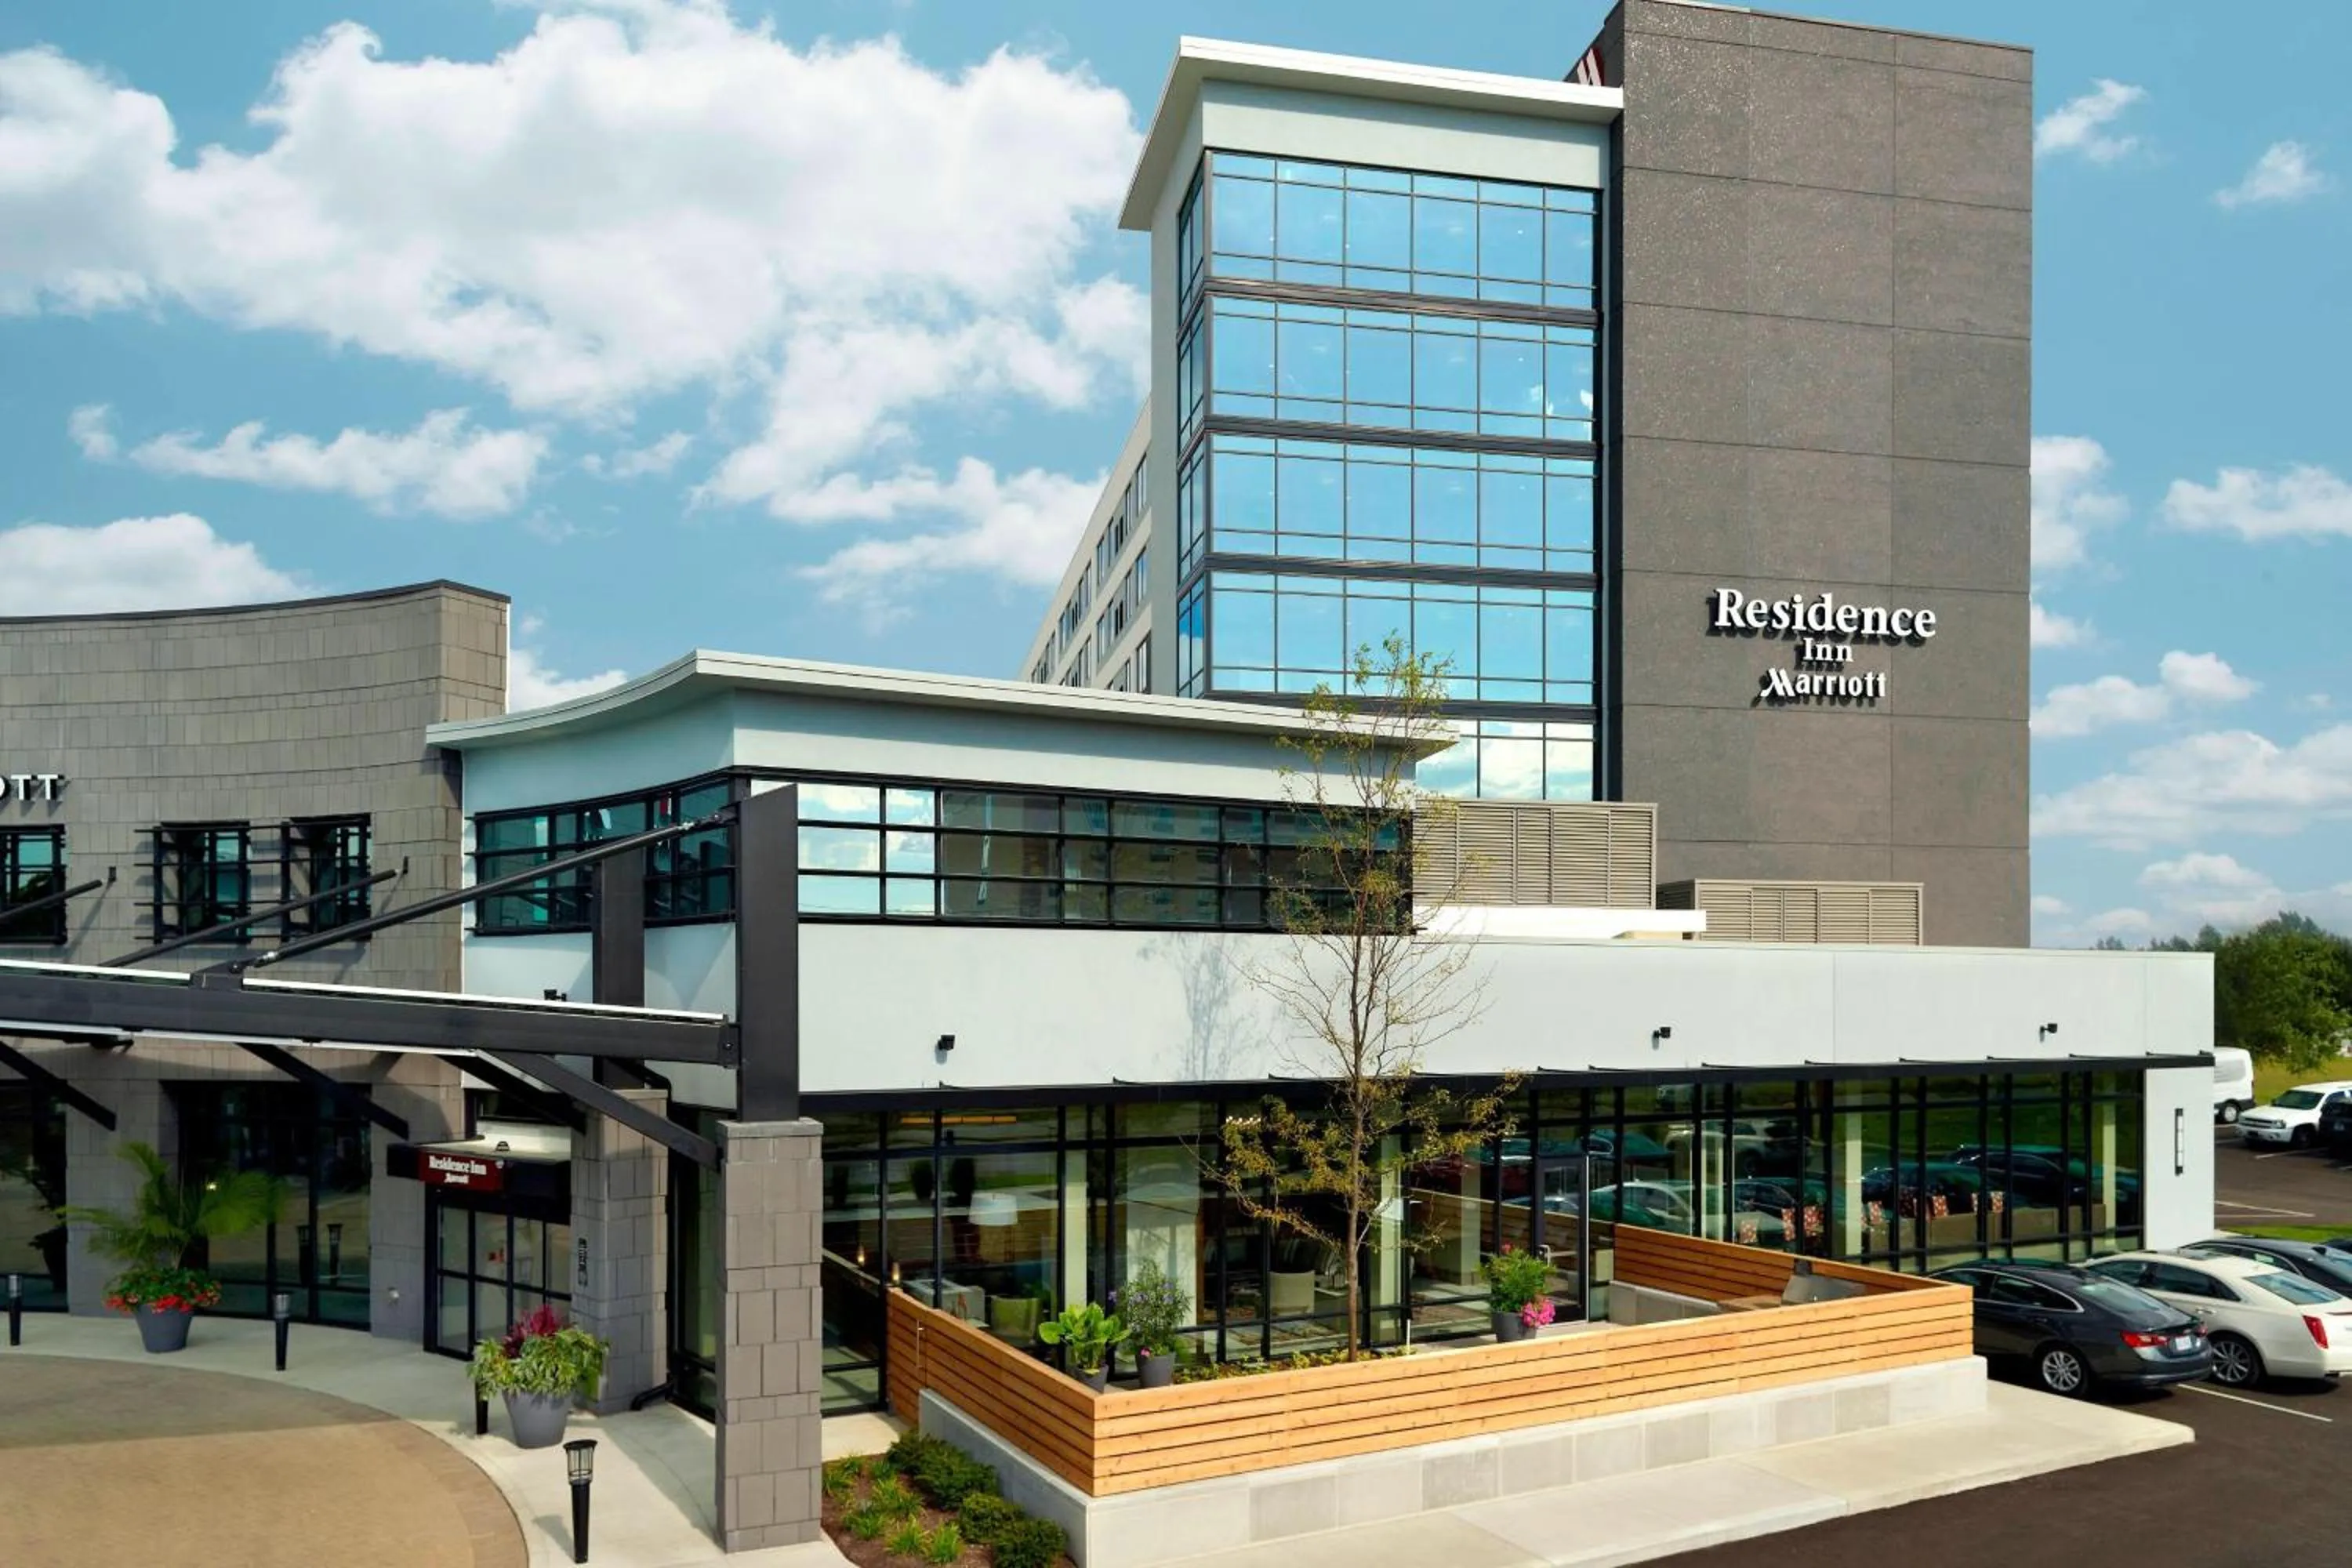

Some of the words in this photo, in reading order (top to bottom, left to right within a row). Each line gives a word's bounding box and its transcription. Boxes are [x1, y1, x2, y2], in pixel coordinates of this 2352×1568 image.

[1714, 587, 1936, 637] Residence
[1802, 637, 1854, 662] Inn
[1760, 667, 1886, 697] Marriott
[0, 774, 58, 800] TT
[429, 1155, 470, 1173] Residence
